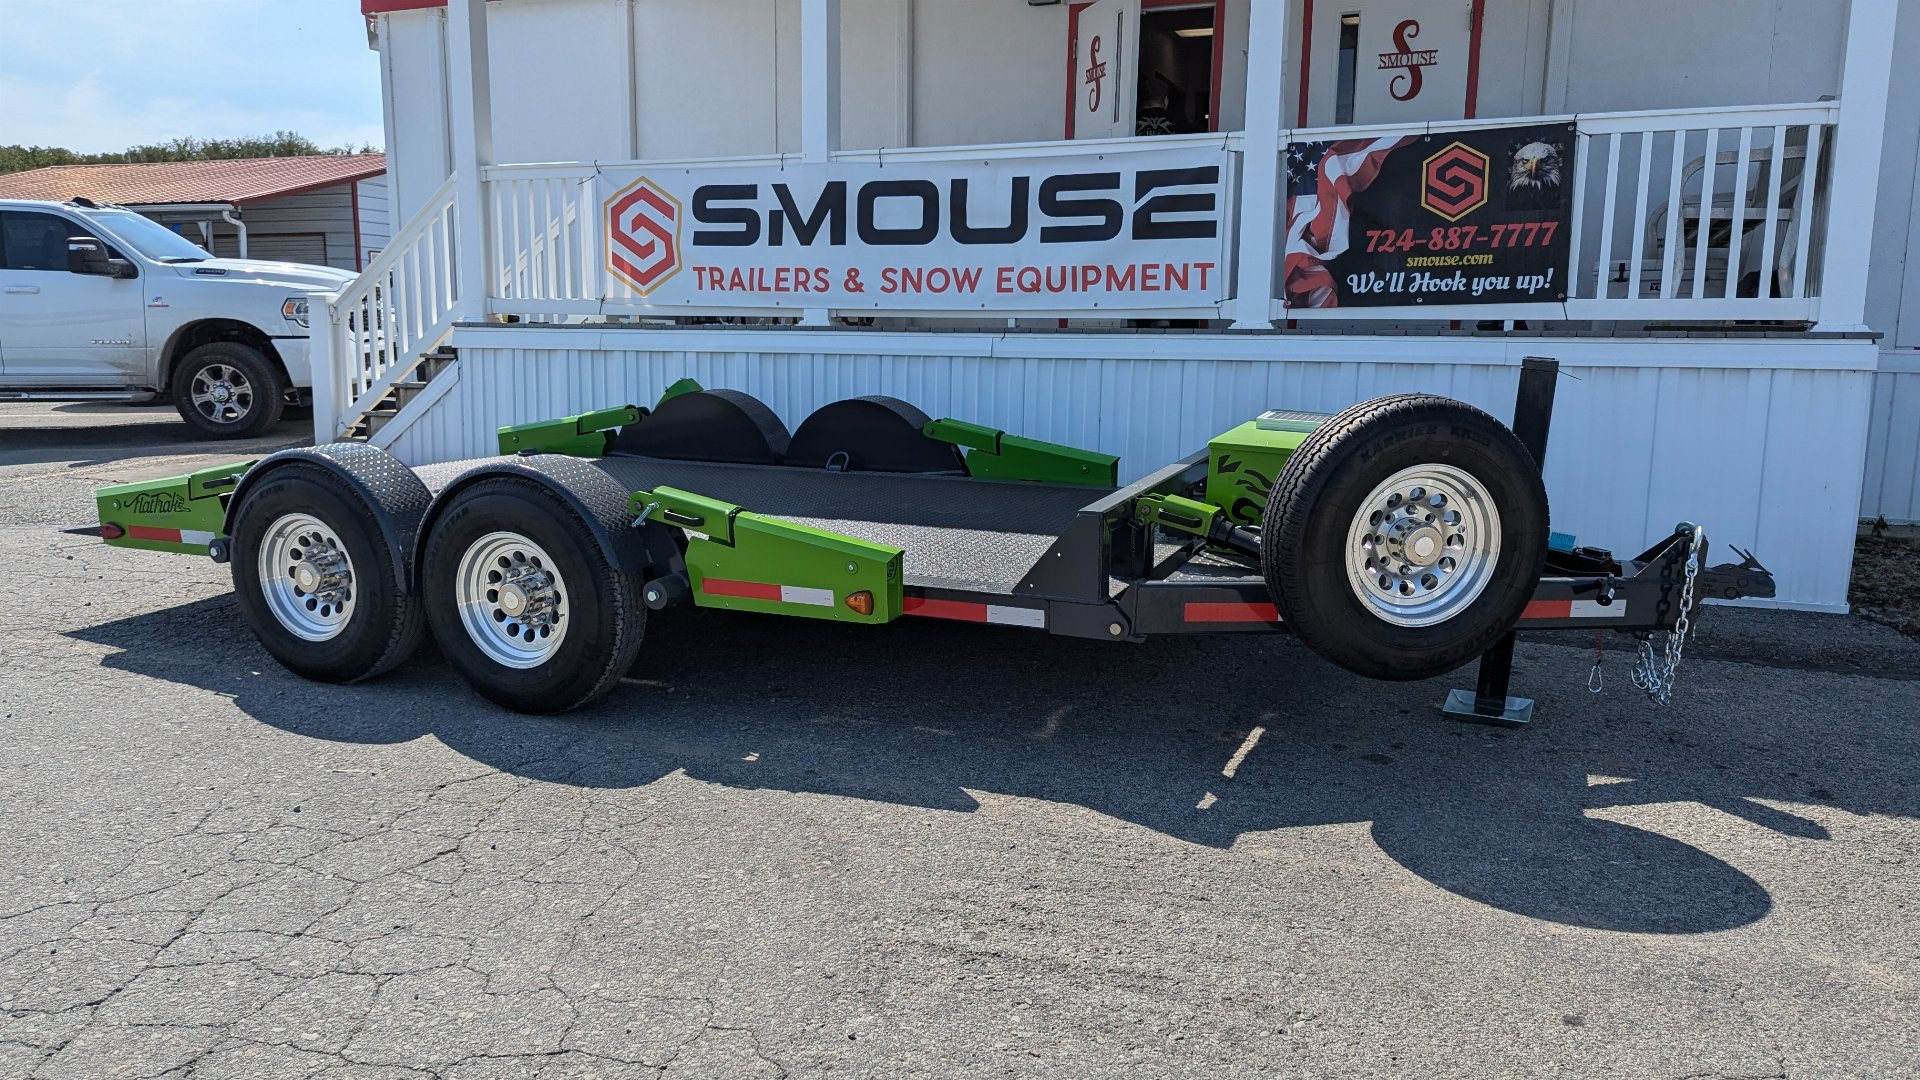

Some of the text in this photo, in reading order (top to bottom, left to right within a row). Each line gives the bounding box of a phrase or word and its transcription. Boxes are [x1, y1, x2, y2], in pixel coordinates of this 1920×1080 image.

[1379, 51, 1437, 69] SMOUSE
[691, 166, 1220, 246] SMOUSE
[1366, 221, 1558, 253] 724-887-7777
[1406, 254, 1494, 267] smouse.com
[693, 262, 1215, 293] TRAILERS & SNOW EQUIPMENT
[1347, 267, 1554, 296] We'll Hook you up!
